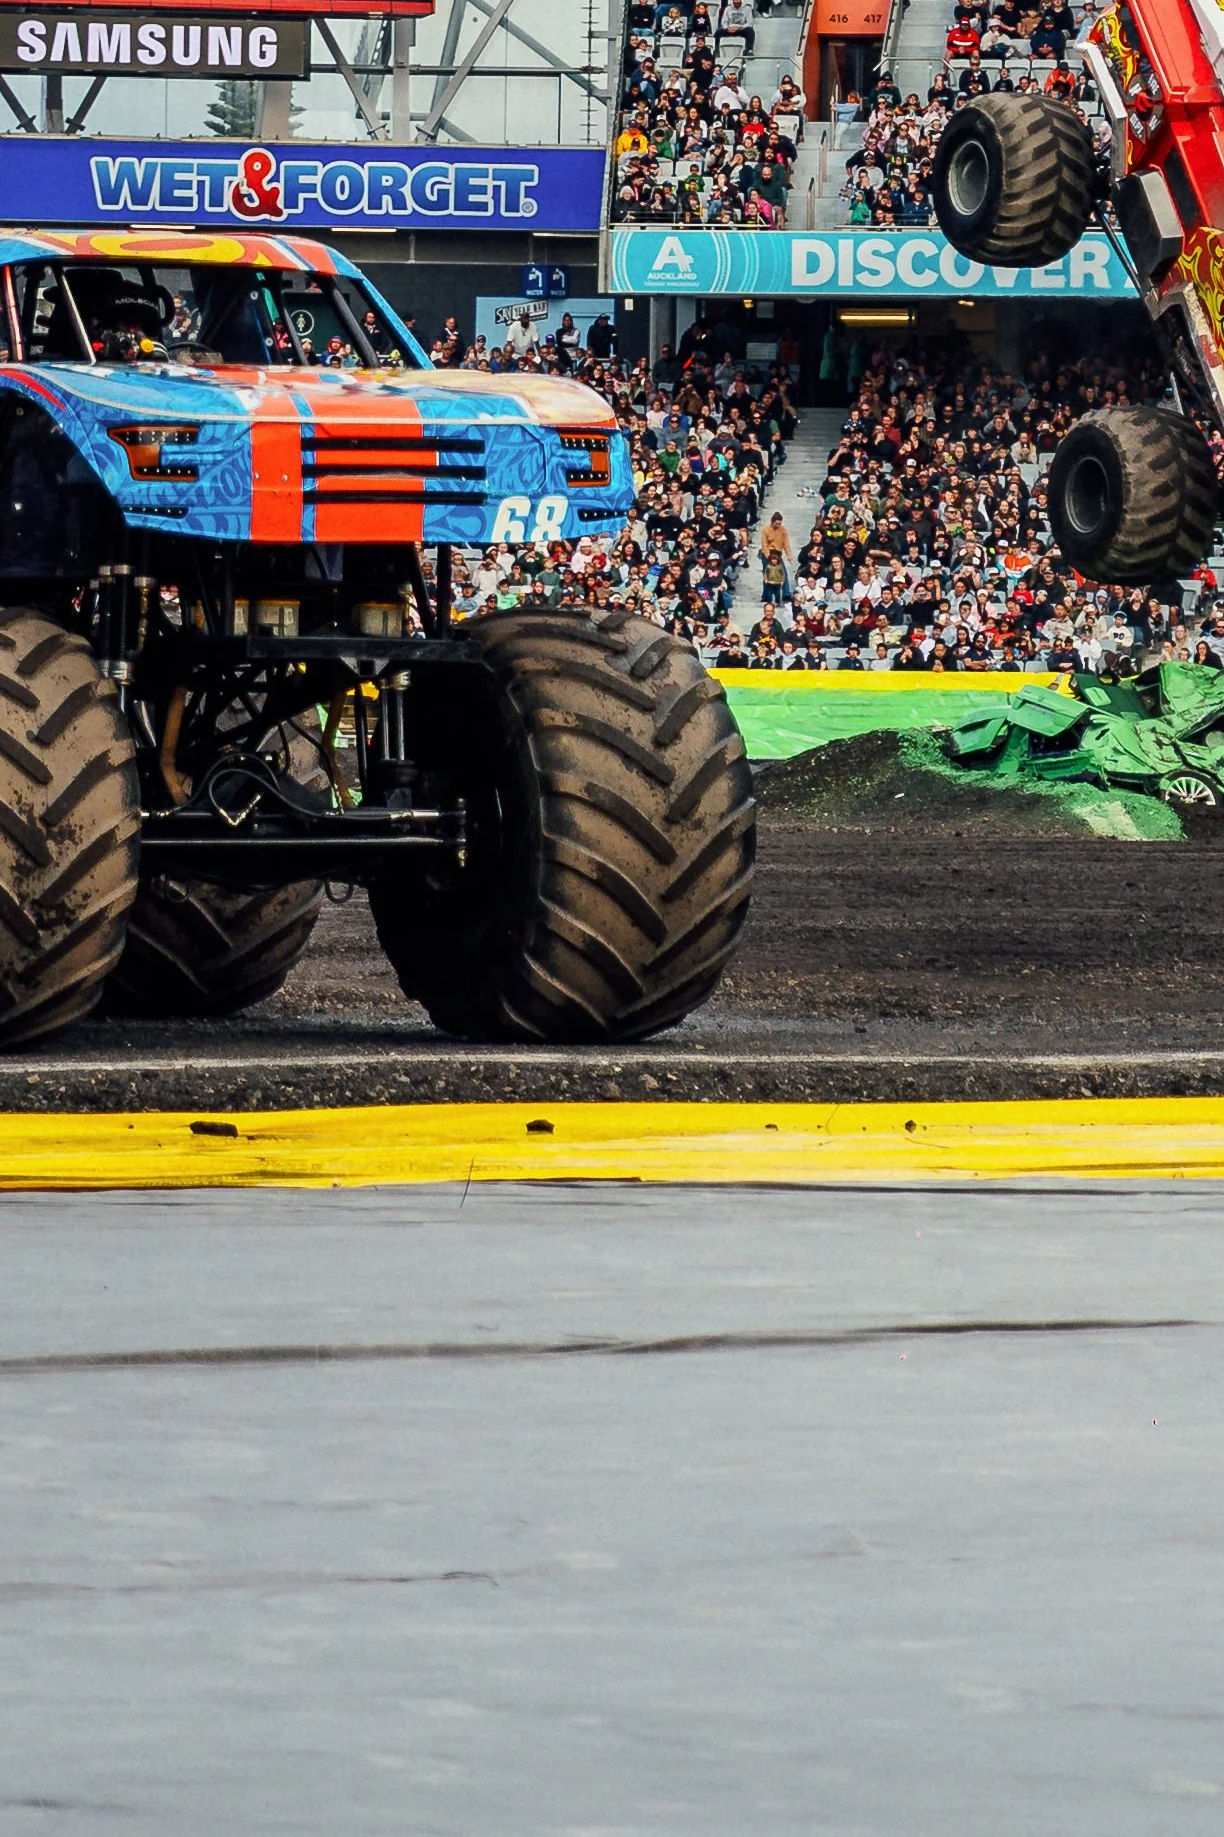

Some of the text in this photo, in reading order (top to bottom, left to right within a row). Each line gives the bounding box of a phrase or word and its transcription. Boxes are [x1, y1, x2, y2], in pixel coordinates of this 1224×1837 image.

[828, 14, 882, 23] 416 417
[17, 20, 278, 68] SAMSUNG
[491, 495, 568, 542] 68
